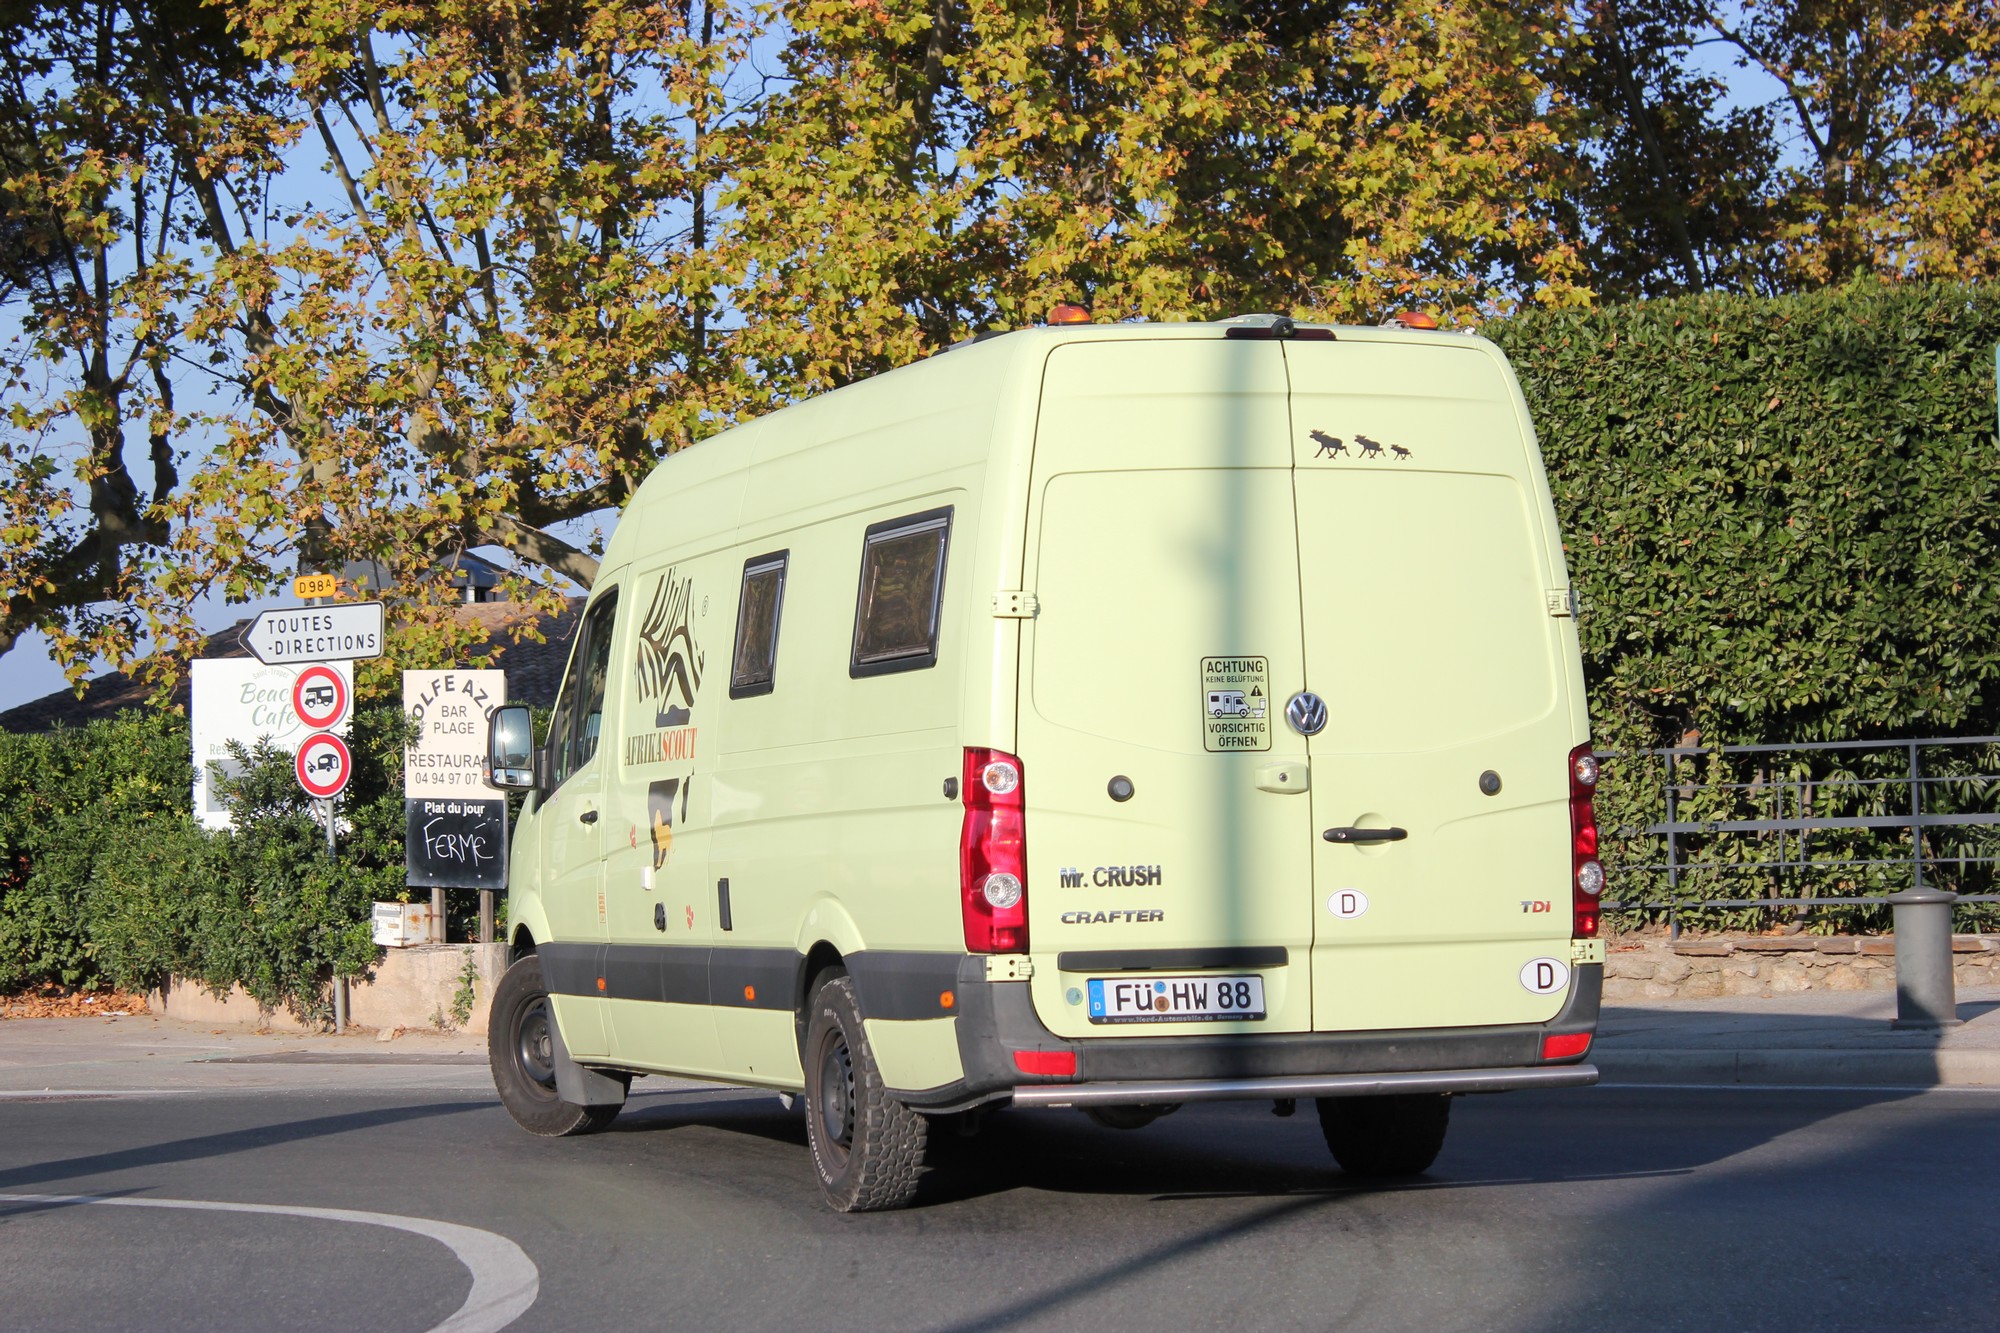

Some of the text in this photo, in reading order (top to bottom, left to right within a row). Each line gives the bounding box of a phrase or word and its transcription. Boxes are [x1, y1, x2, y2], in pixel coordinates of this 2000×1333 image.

[267, 615, 333, 634] TOUTES
[252, 668, 290, 680] Saint-Tropez
[1206, 660, 1263, 673] ACHTUNG
[1226, 674, 1265, 683] BELÜFTUNG
[240, 682, 290, 704] Beac
[411, 674, 495, 723] OLFE AZU
[441, 705, 467, 718] BAR
[433, 721, 475, 734] PLAGE
[1208, 722, 1265, 733] VORSICHTIG
[624, 728, 698, 766] AFRIKASCOUT
[1218, 734, 1258, 747] ÖFFNEN
[408, 754, 484, 768] RESTAURA
[415, 772, 478, 785] 04 94 97 07
[424, 801, 486, 817] Plat du jour
[1060, 865, 1162, 888] Mr. CRUSH
[1341, 893, 1356, 914] D
[1060, 909, 1164, 924] CRAFTER
[1537, 962, 1554, 990] D
[1115, 981, 1252, 1011] FÜ HW 88
